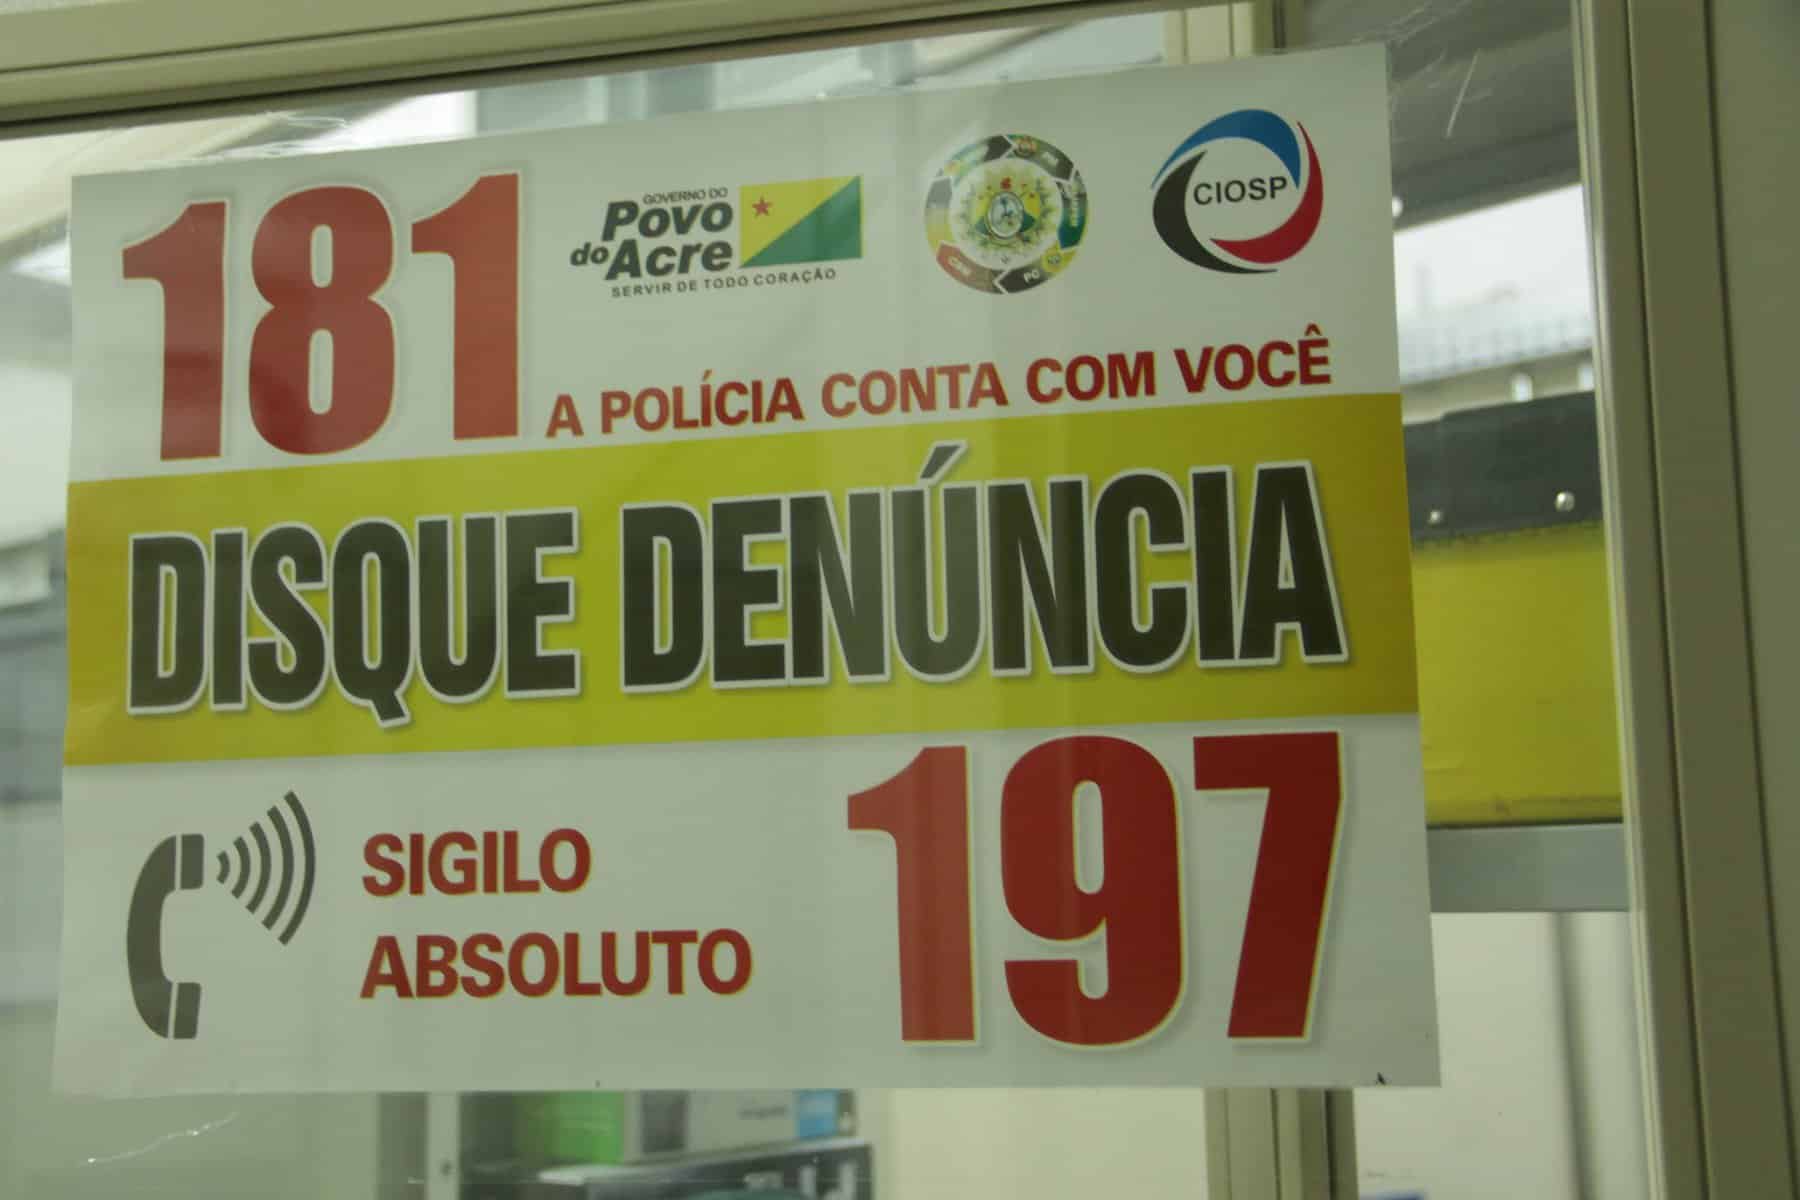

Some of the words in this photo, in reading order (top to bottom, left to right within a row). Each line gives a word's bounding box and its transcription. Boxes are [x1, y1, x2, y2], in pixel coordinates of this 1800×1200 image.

[602, 200, 733, 242] Povo
[643, 188, 706, 205] GOVERNO
[709, 187, 728, 198] DO
[1193, 176, 1287, 205] CIOSP
[570, 242, 609, 266] do
[604, 239, 733, 280] Acre
[611, 283, 672, 298] SERVIR
[678, 280, 697, 292] DE
[704, 276, 748, 290] TODO
[753, 267, 836, 287] CORAÇÃO
[122, 172, 519, 461] 181
[546, 394, 584, 438] A
[601, 370, 805, 435] POLÍCIA
[821, 364, 1009, 418] CONTA
[1026, 350, 1156, 404] COM
[1174, 323, 1331, 393] VOCÊ
[128, 507, 581, 728] DISQUE
[621, 441, 1348, 692] DENÚNCIA
[362, 828, 592, 897] SIGILO
[848, 731, 1344, 1047] 197
[360, 928, 752, 999] ABSOLUTO
